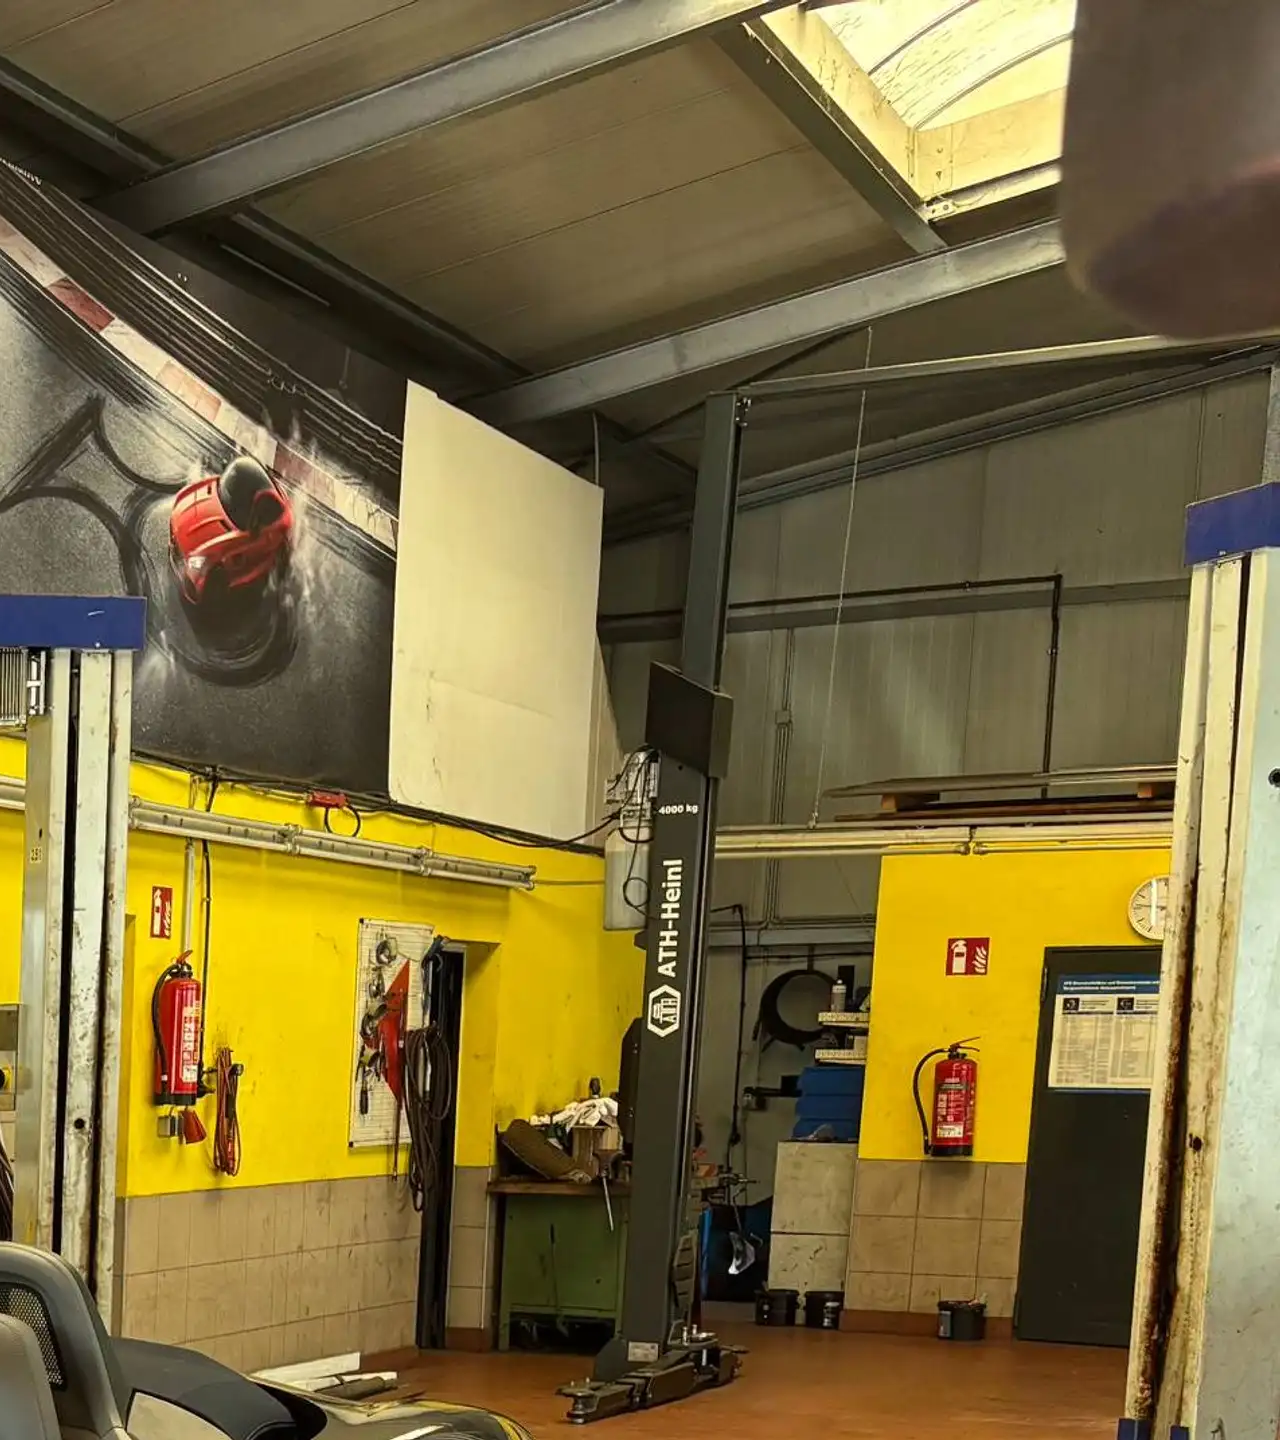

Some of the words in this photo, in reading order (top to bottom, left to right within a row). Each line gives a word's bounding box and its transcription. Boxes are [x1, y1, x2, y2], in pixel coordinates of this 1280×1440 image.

[657, 804, 684, 815] 4000
[685, 803, 699, 814] kg
[657, 858, 683, 978] ATH-Heinl
[659, 997, 678, 1024] ATH
